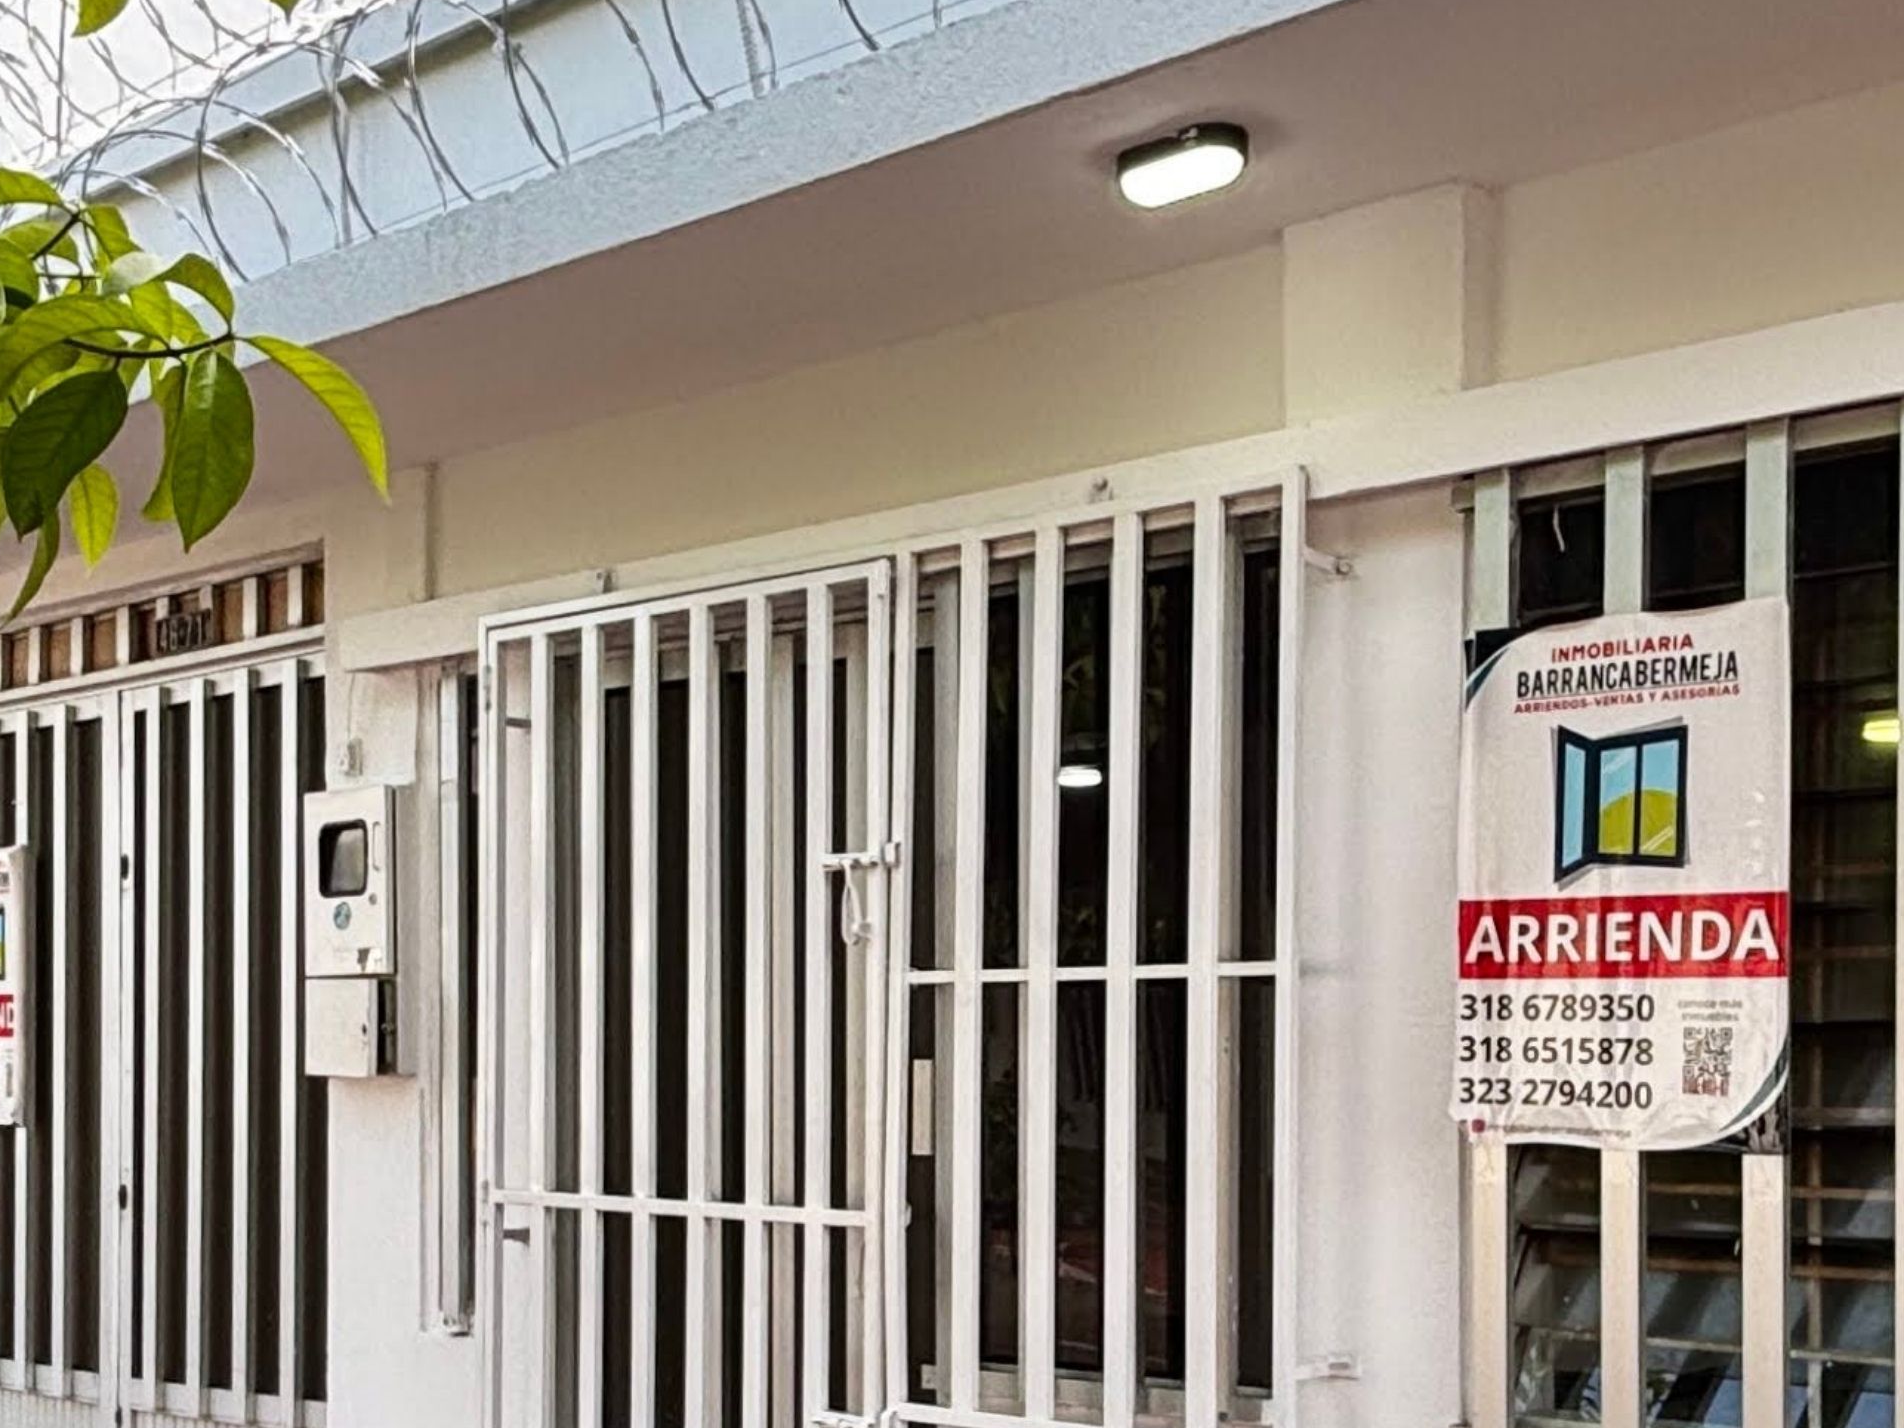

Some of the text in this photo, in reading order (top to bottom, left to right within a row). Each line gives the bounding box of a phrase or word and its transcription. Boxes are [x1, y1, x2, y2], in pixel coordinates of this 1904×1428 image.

[1551, 633, 1694, 664] INMOBILIARIA
[1516, 650, 1739, 698] BARRANCABERMEJA
[1464, 908, 1780, 964] ARRIENDA
[1460, 994, 1655, 1022] 318 6789350
[1459, 1035, 1653, 1065] 318 6515878
[1459, 1077, 1653, 1108] 323 2794200
